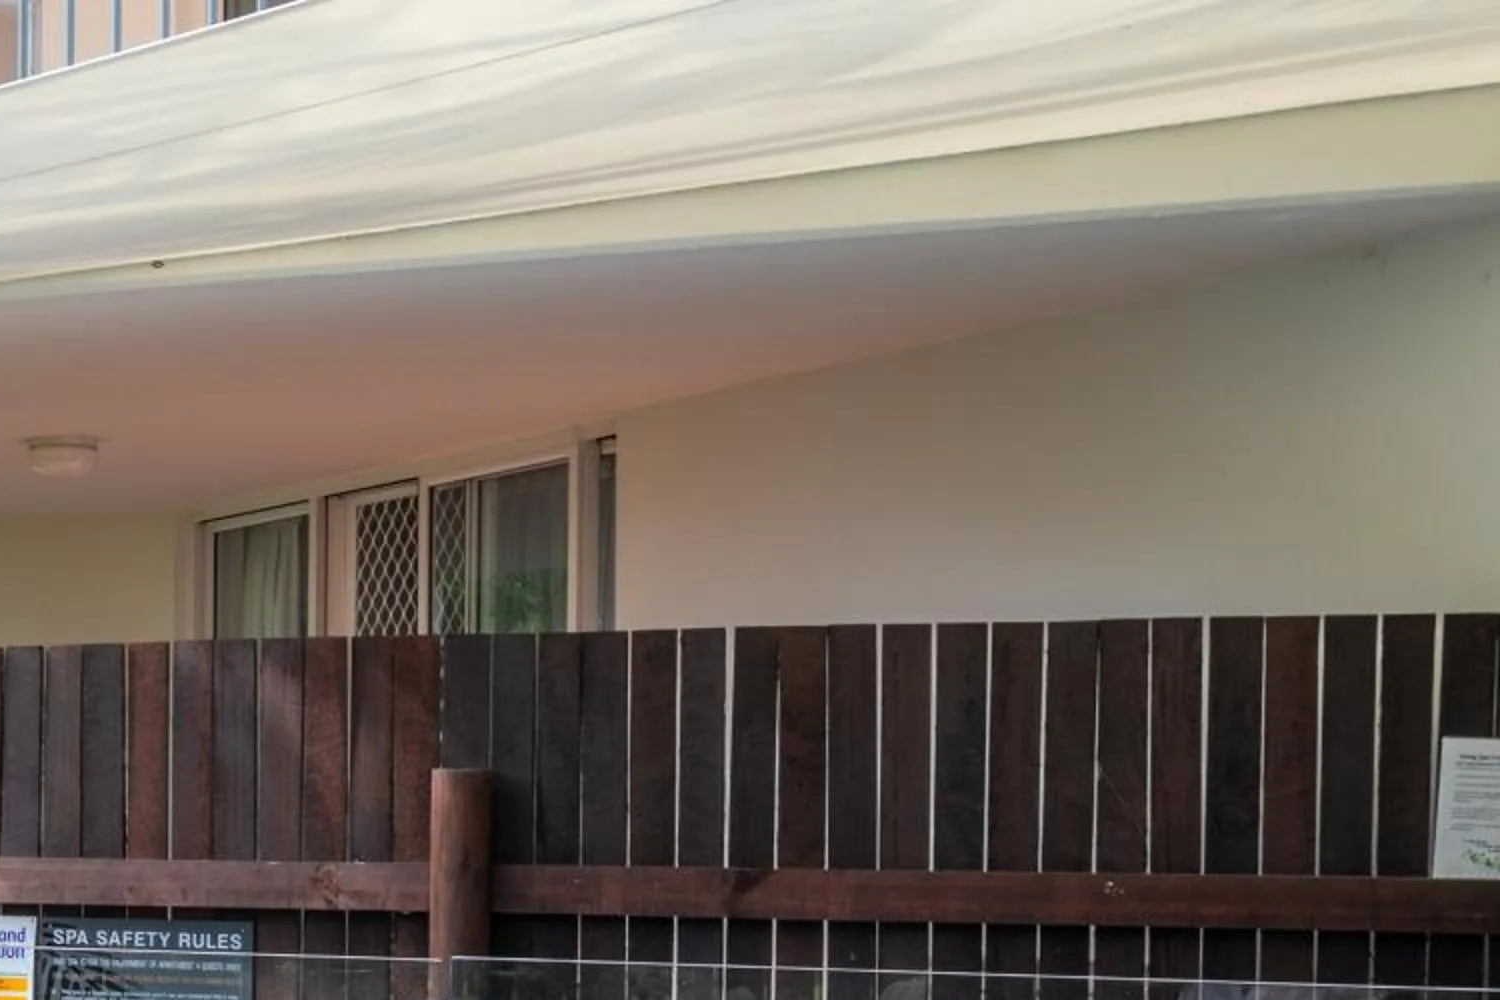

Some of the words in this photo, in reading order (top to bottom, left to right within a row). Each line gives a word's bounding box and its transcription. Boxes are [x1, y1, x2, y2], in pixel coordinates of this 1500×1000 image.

[53, 929, 89, 946] SPA
[96, 930, 171, 948] SAFETY
[178, 932, 243, 950] RULES
